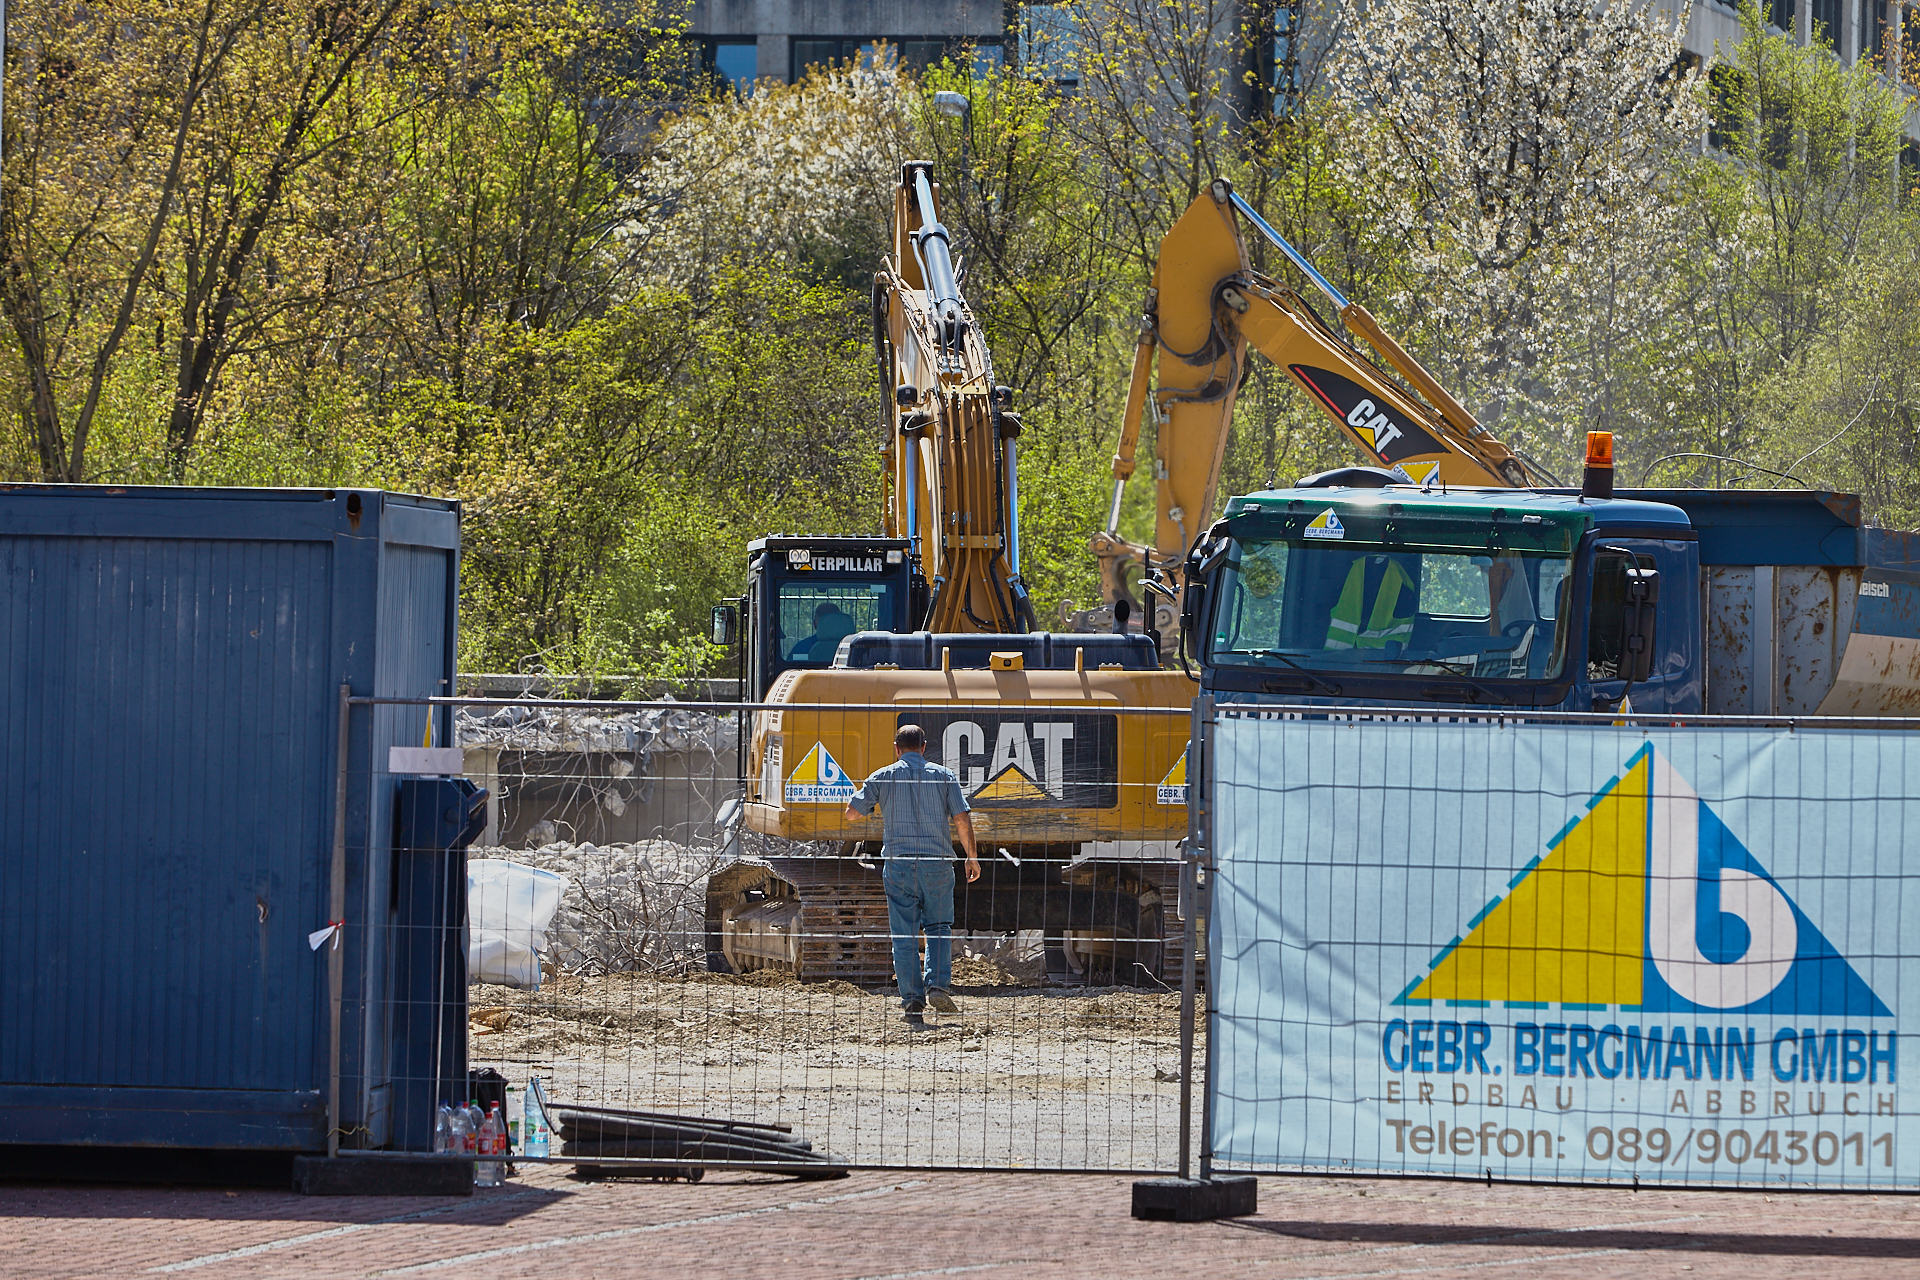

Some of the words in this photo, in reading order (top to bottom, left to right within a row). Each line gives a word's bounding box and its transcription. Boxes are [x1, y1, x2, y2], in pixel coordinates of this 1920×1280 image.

[1347, 399, 1402, 453] CAT
[793, 557, 882, 572] CTERPILLAR
[942, 720, 1073, 800] CAT
[785, 787, 806, 796] GEBR.
[808, 787, 854, 796] BERGMANN
[1158, 788, 1181, 798] GEBR.
[1382, 1018, 1502, 1075] GEBR.
[1514, 1021, 1756, 1081] BERGMANN
[1771, 1027, 1897, 1084] GMBH
[1387, 1080, 1573, 1110] ERDBAU
[1670, 1089, 1895, 1116] ABBRUCH
[1386, 1119, 1566, 1160] Telefon:
[1587, 1126, 1894, 1167] 089/9043011
